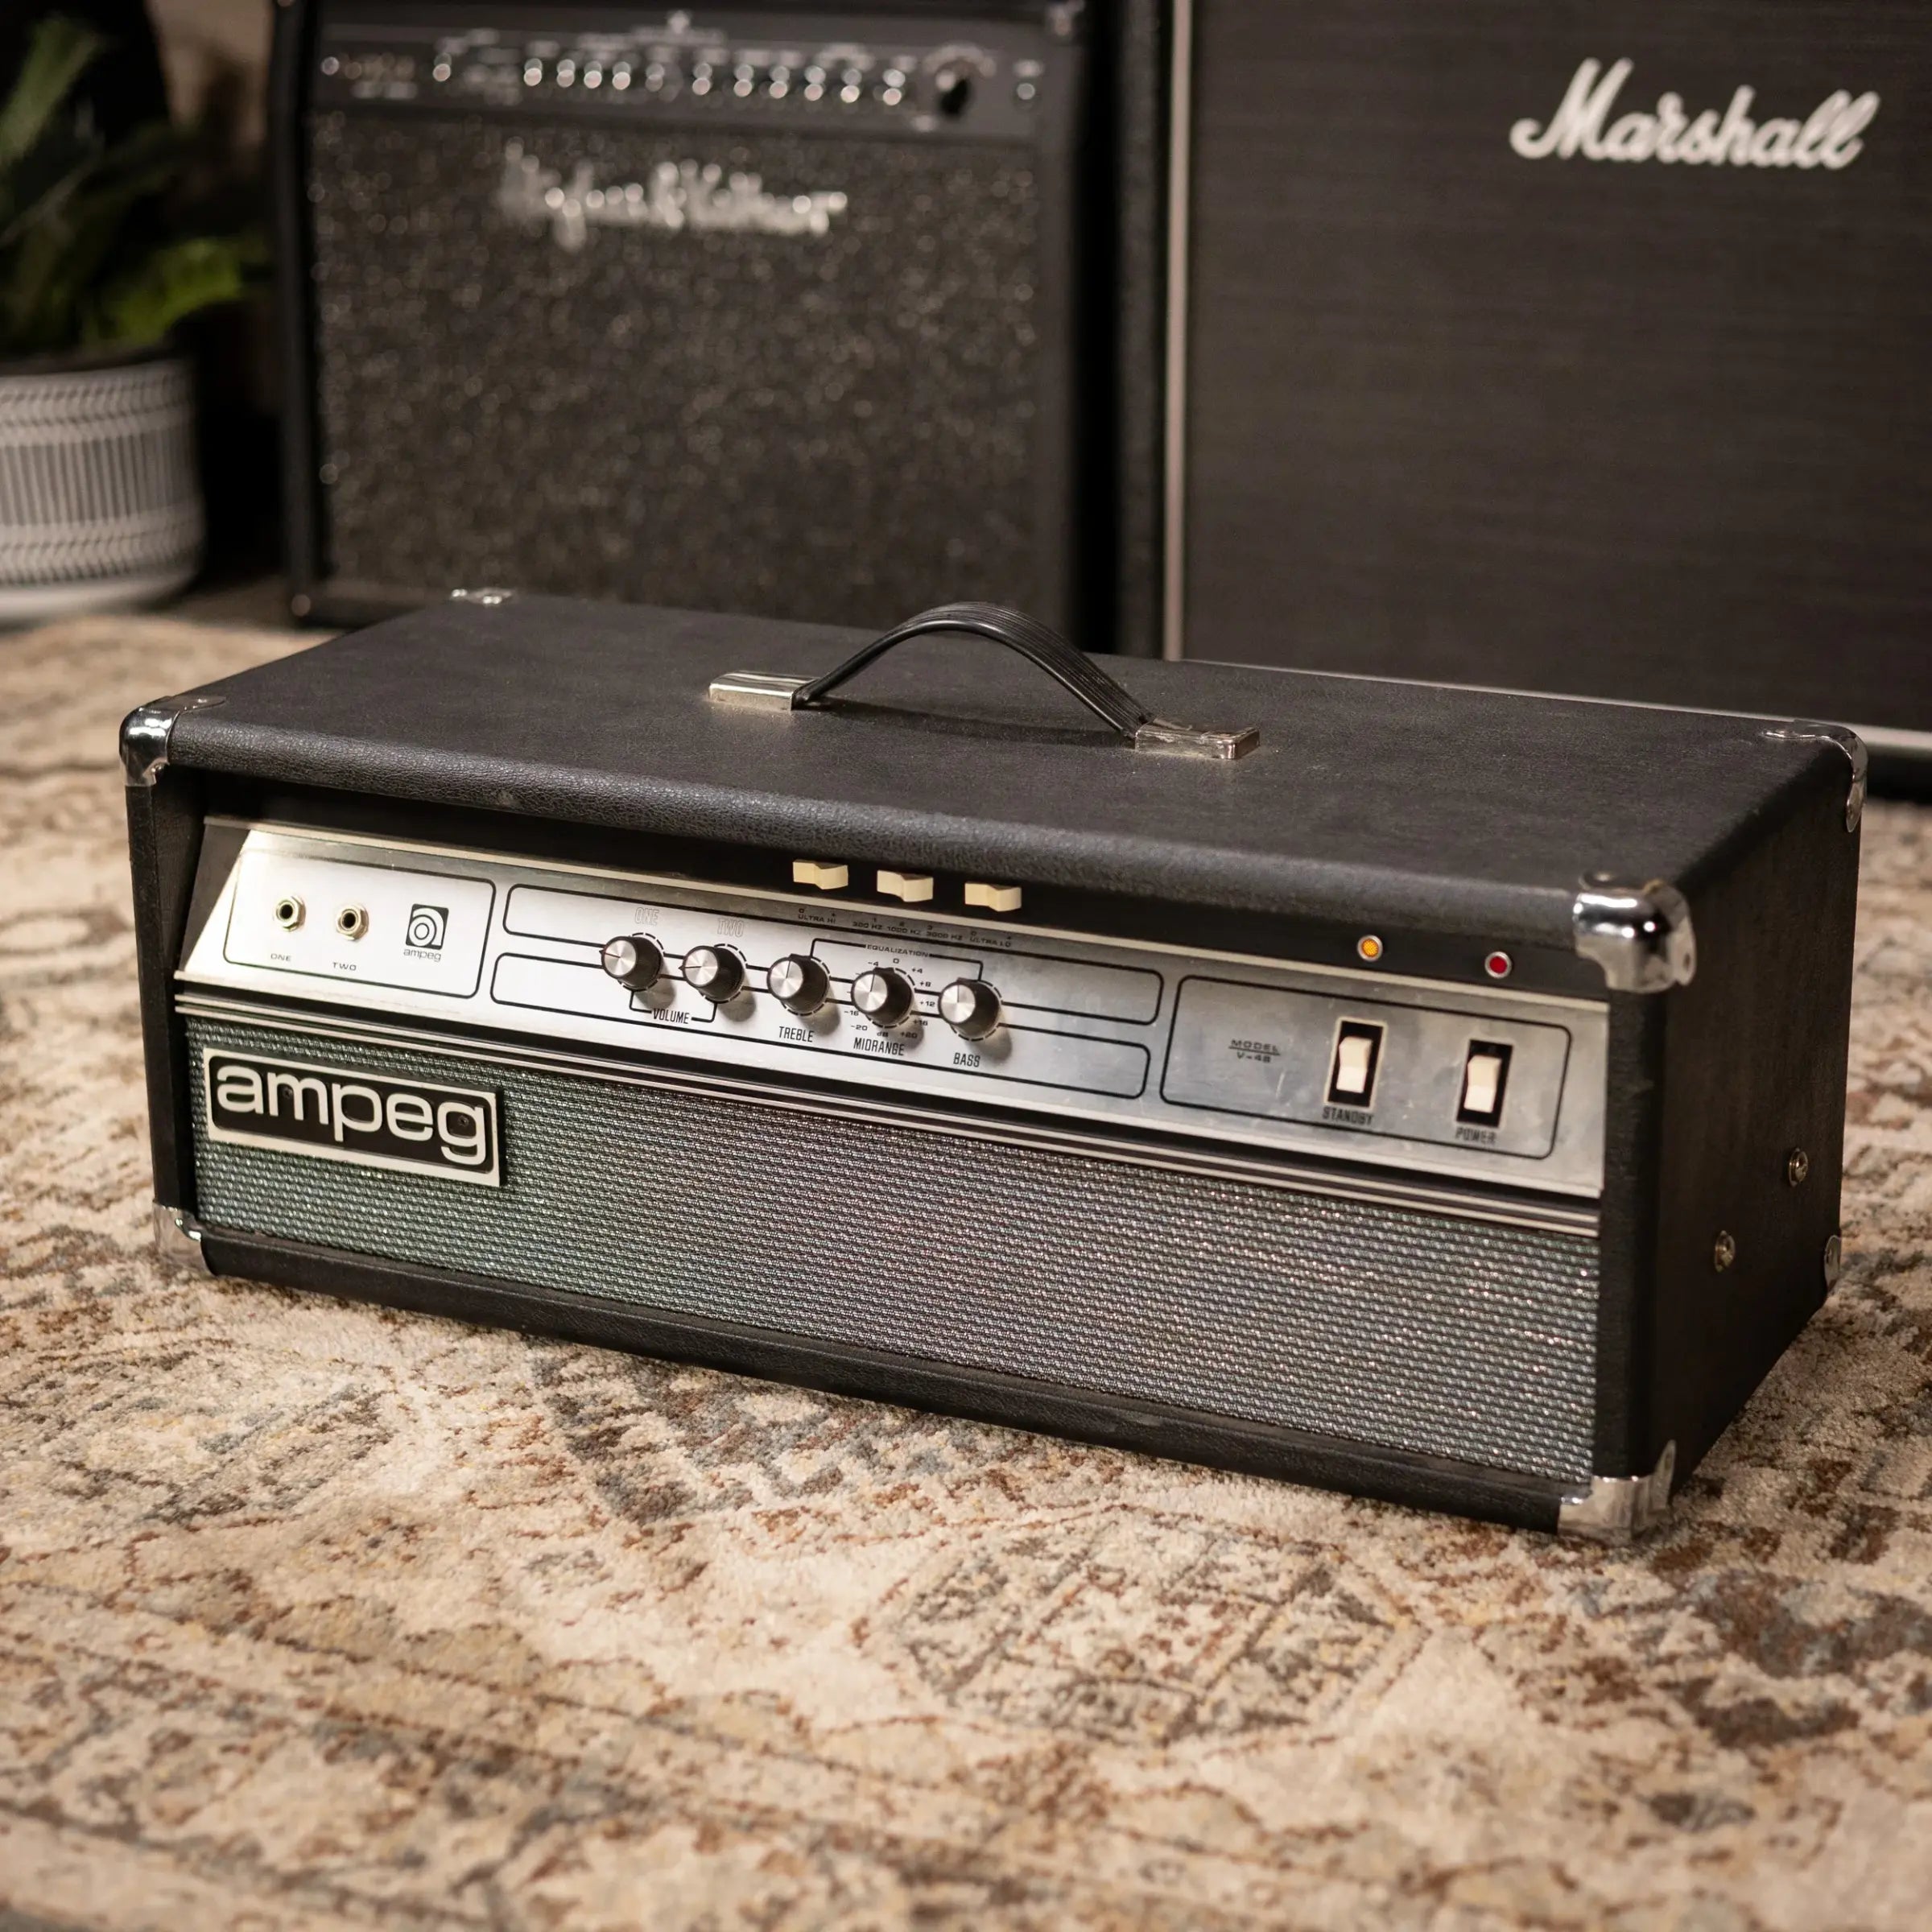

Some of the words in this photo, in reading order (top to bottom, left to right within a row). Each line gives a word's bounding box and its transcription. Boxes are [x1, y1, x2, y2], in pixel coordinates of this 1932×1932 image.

[1509, 56, 1880, 170] Marshall
[634, 906, 659, 926] ONE
[718, 917, 745, 937] TWO
[969, 937, 997, 946] ULTRA
[270, 952, 291, 962] ONE
[403, 948, 442, 962] ampeg
[867, 944, 930, 957] EQUALIZATION
[332, 962, 357, 971] TWO
[653, 1008, 690, 1024] VOLUME
[778, 1026, 814, 1042] TREBLE
[853, 1036, 905, 1056] MIDRANGE
[1231, 1039, 1279, 1055] MODEL
[953, 1052, 980, 1067] BASS
[216, 1064, 487, 1166] ampeg
[1322, 1106, 1374, 1125] STANDBY
[1455, 1127, 1496, 1145] POWER
